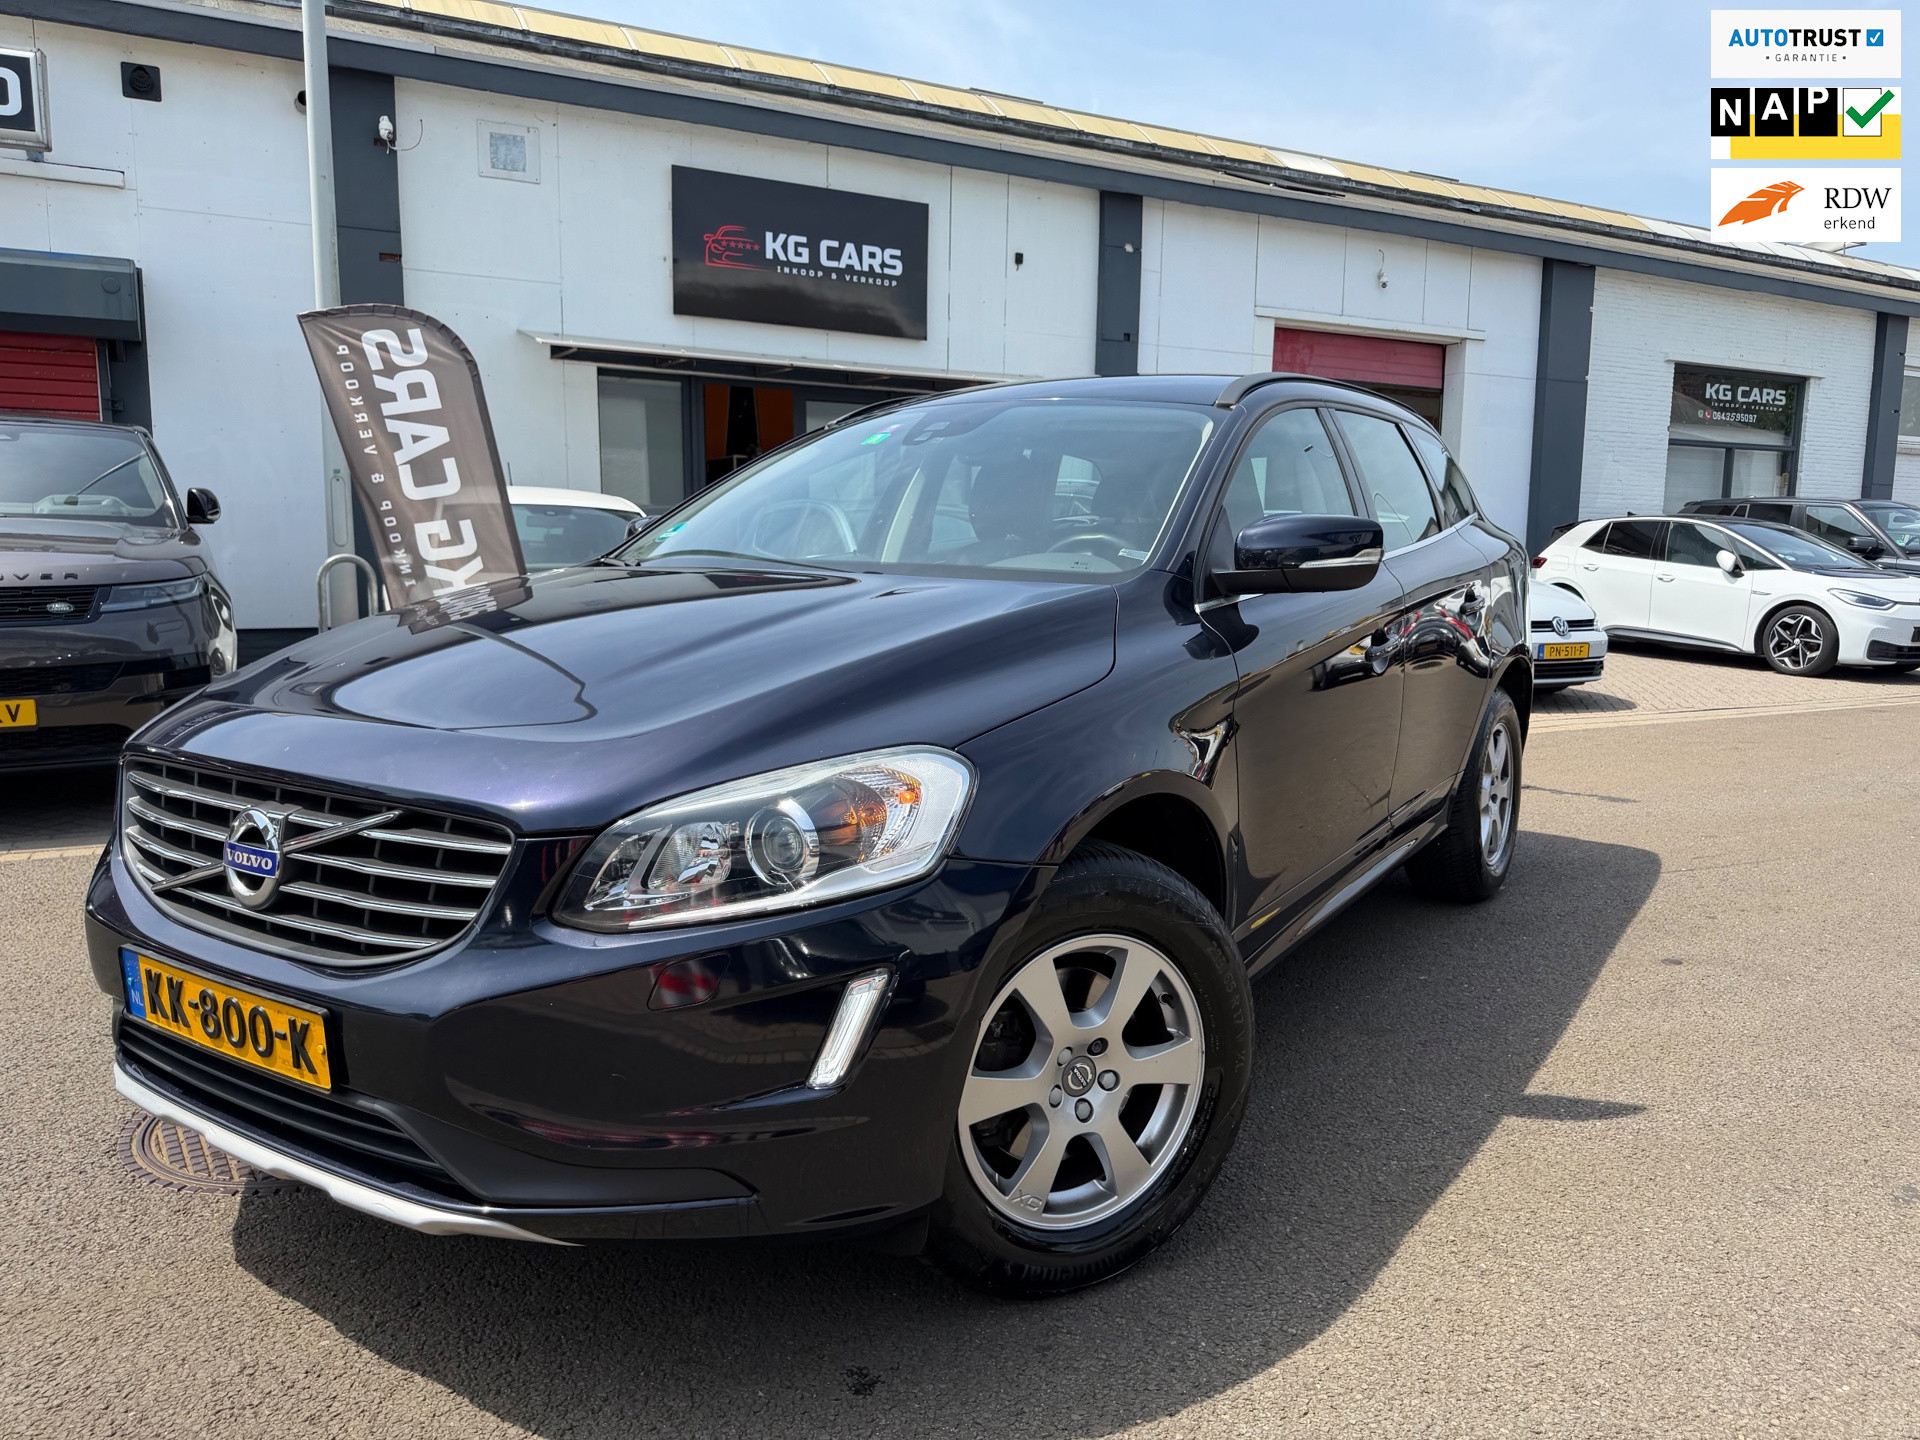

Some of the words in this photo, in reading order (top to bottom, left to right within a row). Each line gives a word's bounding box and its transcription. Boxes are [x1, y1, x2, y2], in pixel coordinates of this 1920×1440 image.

[765, 231, 809, 263] KG
[819, 239, 903, 276] CARS
[776, 265, 823, 278] INKOOP
[844, 274, 898, 287] VERKOOP
[1705, 382, 1732, 400] KG
[1737, 386, 1787, 406] CARS
[226, 847, 273, 870] VOLVO
[131, 991, 144, 1006] NL
[145, 967, 317, 1075] KK-800-K
